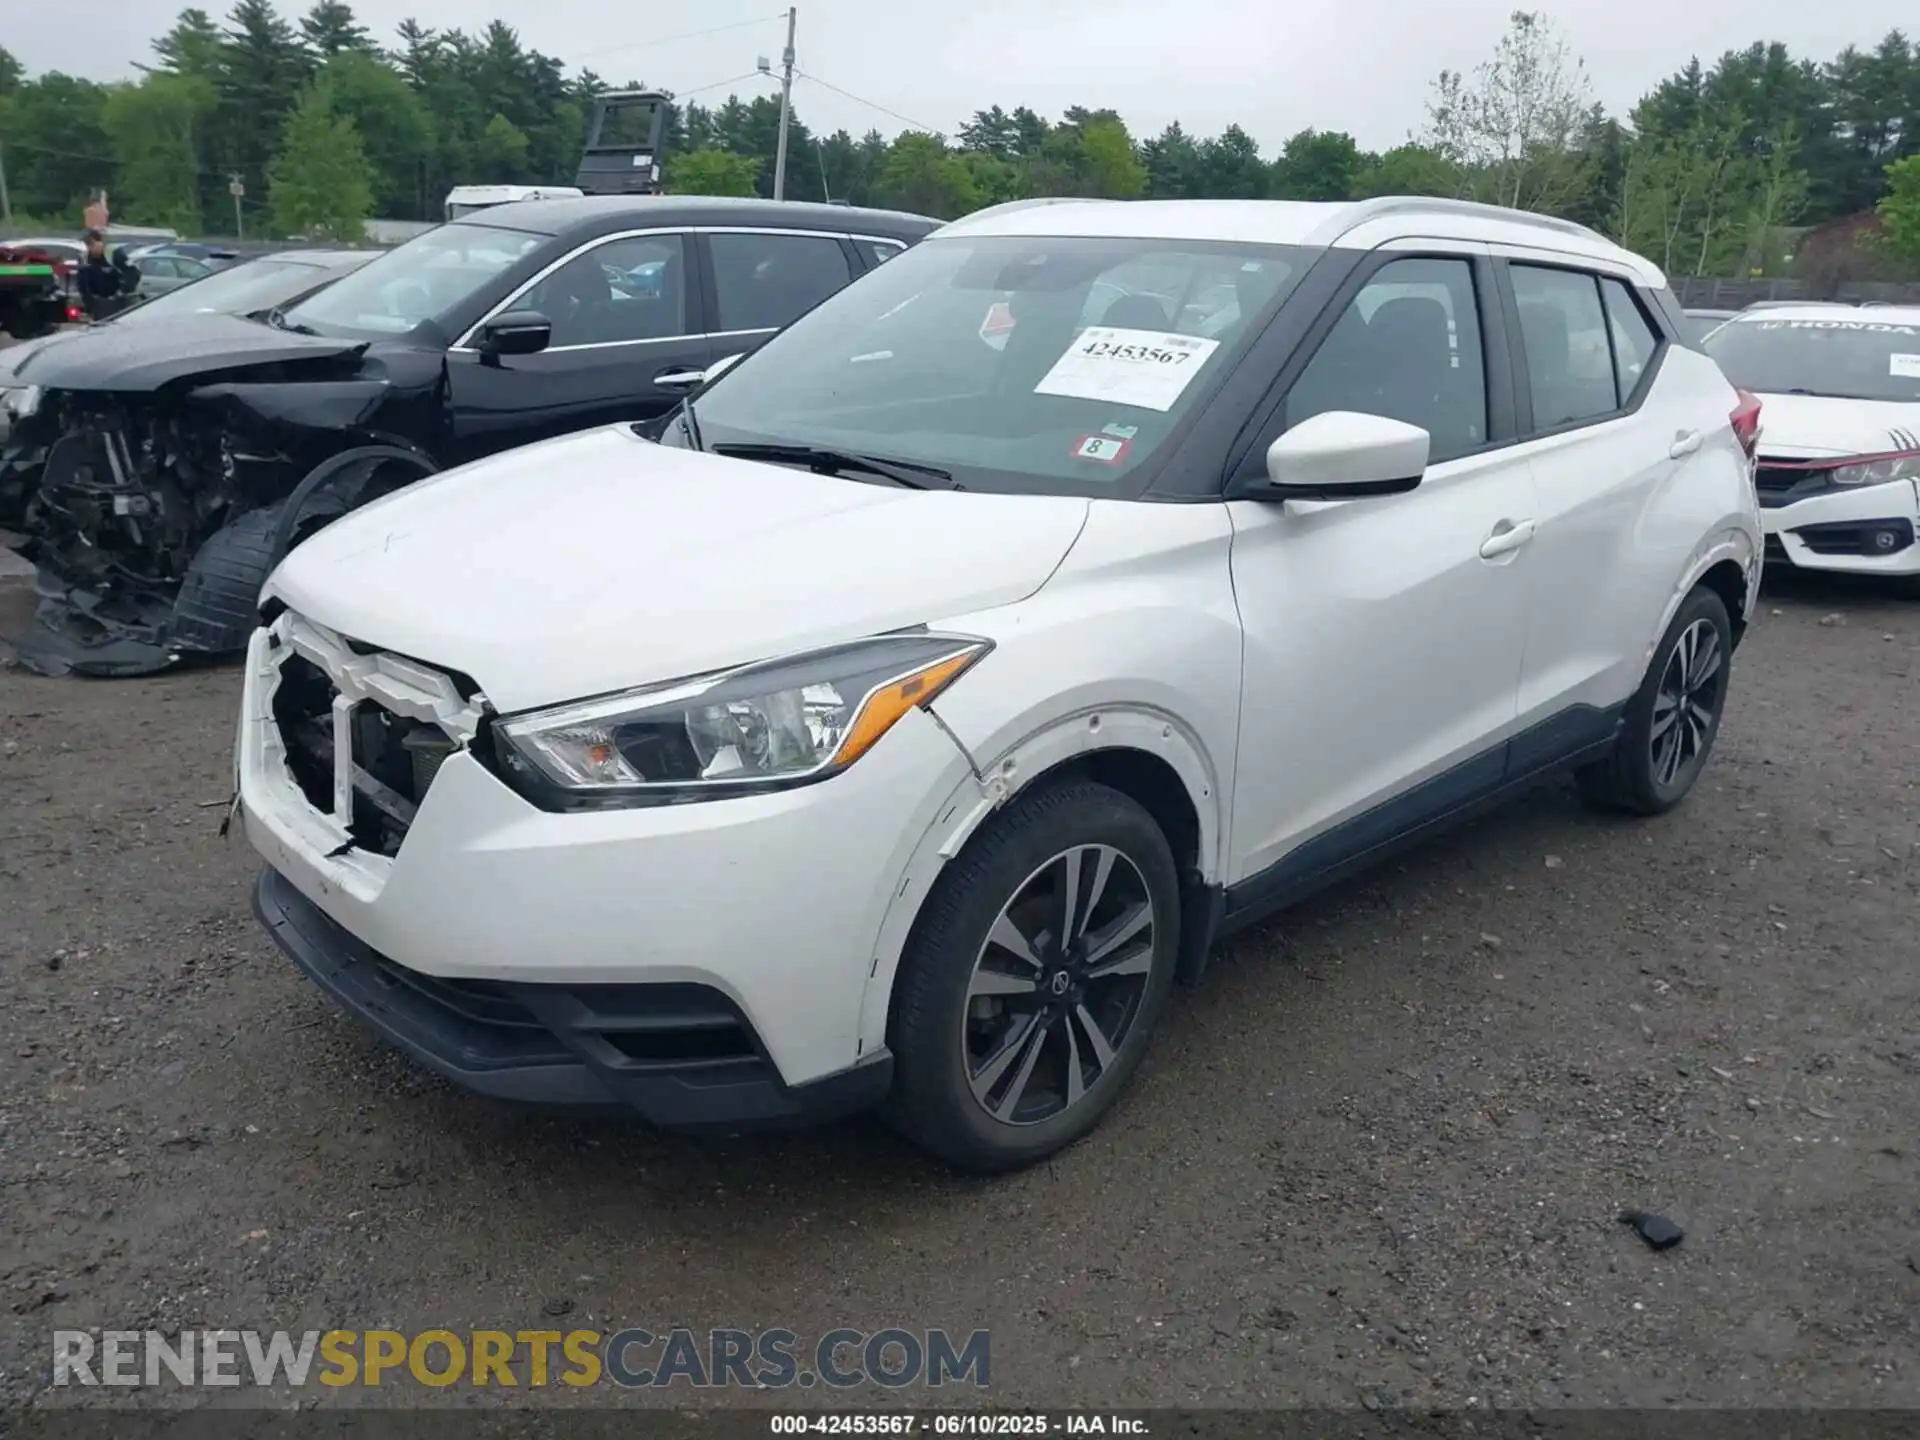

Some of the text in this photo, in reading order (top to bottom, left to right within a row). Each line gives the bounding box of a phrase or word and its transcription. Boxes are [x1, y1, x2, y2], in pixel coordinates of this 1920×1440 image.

[1788, 321, 1917, 335] HONDA
[1082, 340, 1191, 365] 42453567
[1086, 439, 1103, 454] 8
